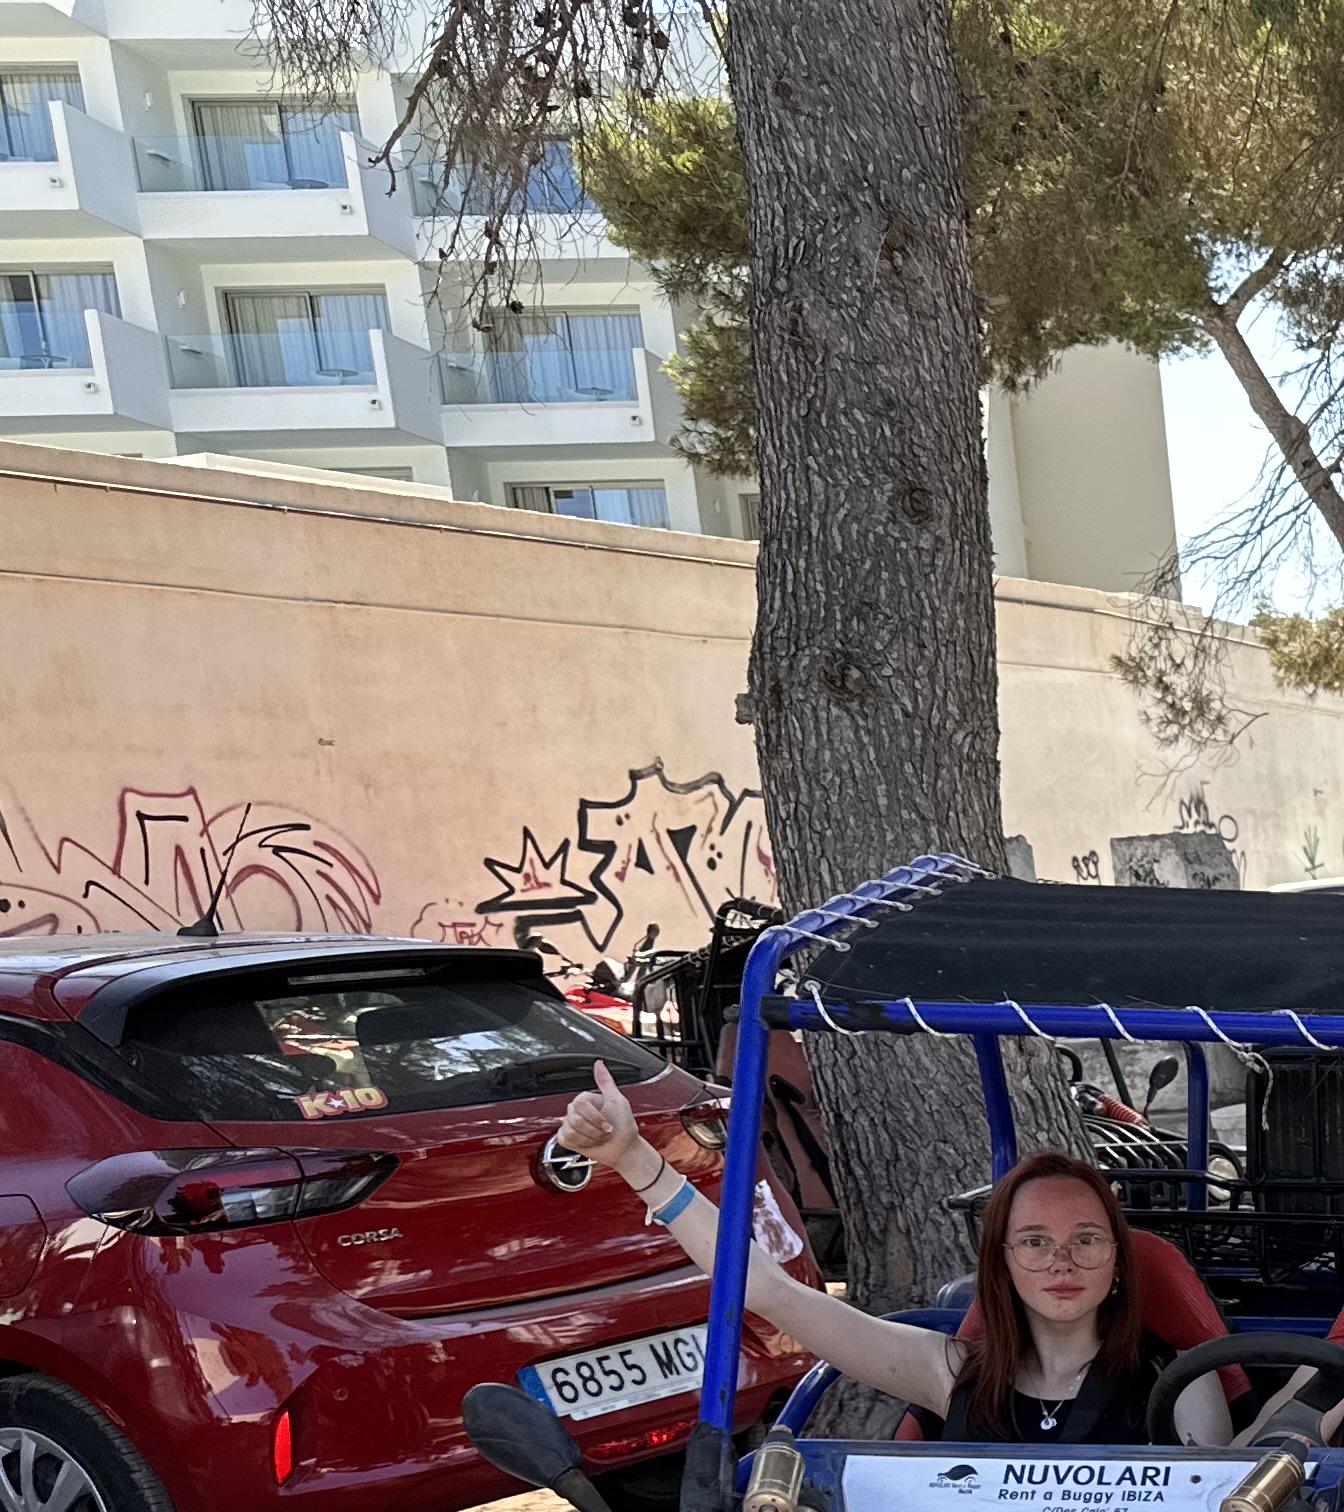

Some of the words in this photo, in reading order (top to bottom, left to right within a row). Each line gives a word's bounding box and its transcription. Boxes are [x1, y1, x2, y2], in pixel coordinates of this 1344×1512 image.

[337, 1227, 404, 1247] CORSA
[551, 1349, 648, 1404] 6855
[1003, 1463, 1171, 1487] NUVOLARI
[998, 1488, 1036, 1501] Rent
[1043, 1491, 1053, 1501] a
[1061, 1489, 1114, 1504] Buggy
[1121, 1490, 1165, 1502] IBIZA
